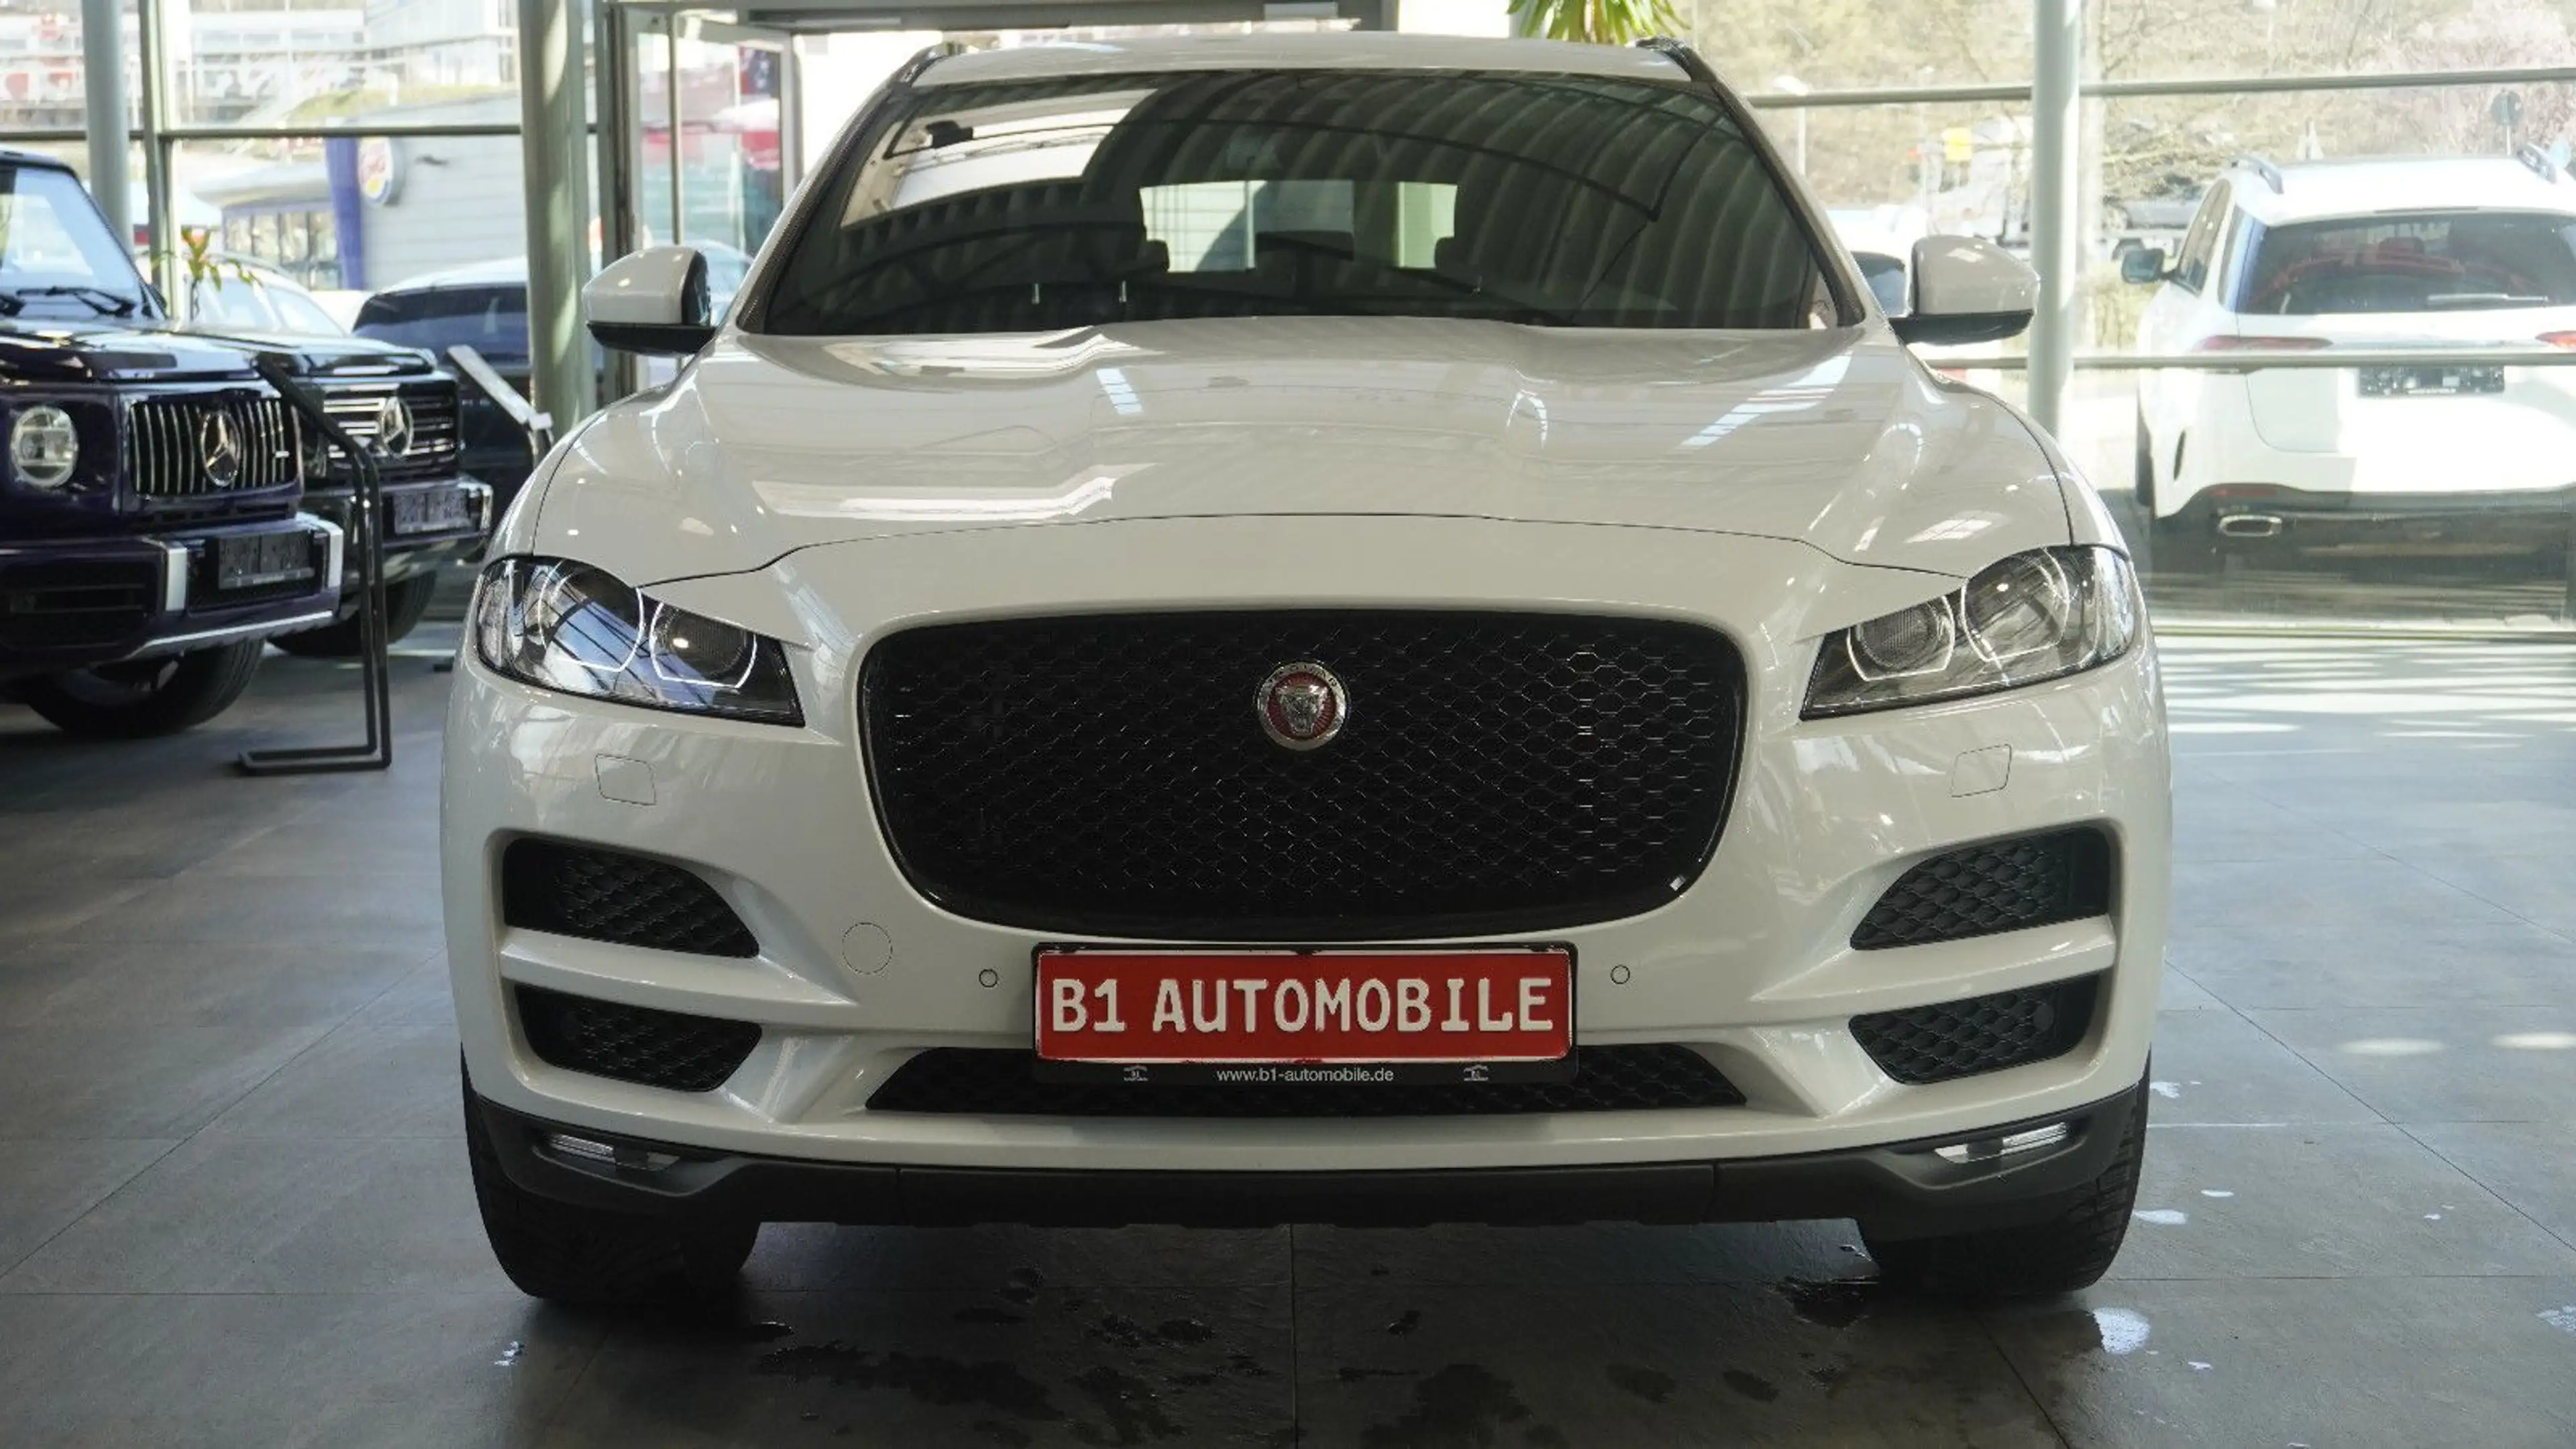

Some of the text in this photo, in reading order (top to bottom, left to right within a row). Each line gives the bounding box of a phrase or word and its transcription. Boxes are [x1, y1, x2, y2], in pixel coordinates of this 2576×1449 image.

[1053, 977, 1554, 1032] B1 AUTOMOBILE
[1216, 1067, 1394, 1081] www.b1-automobile.de
